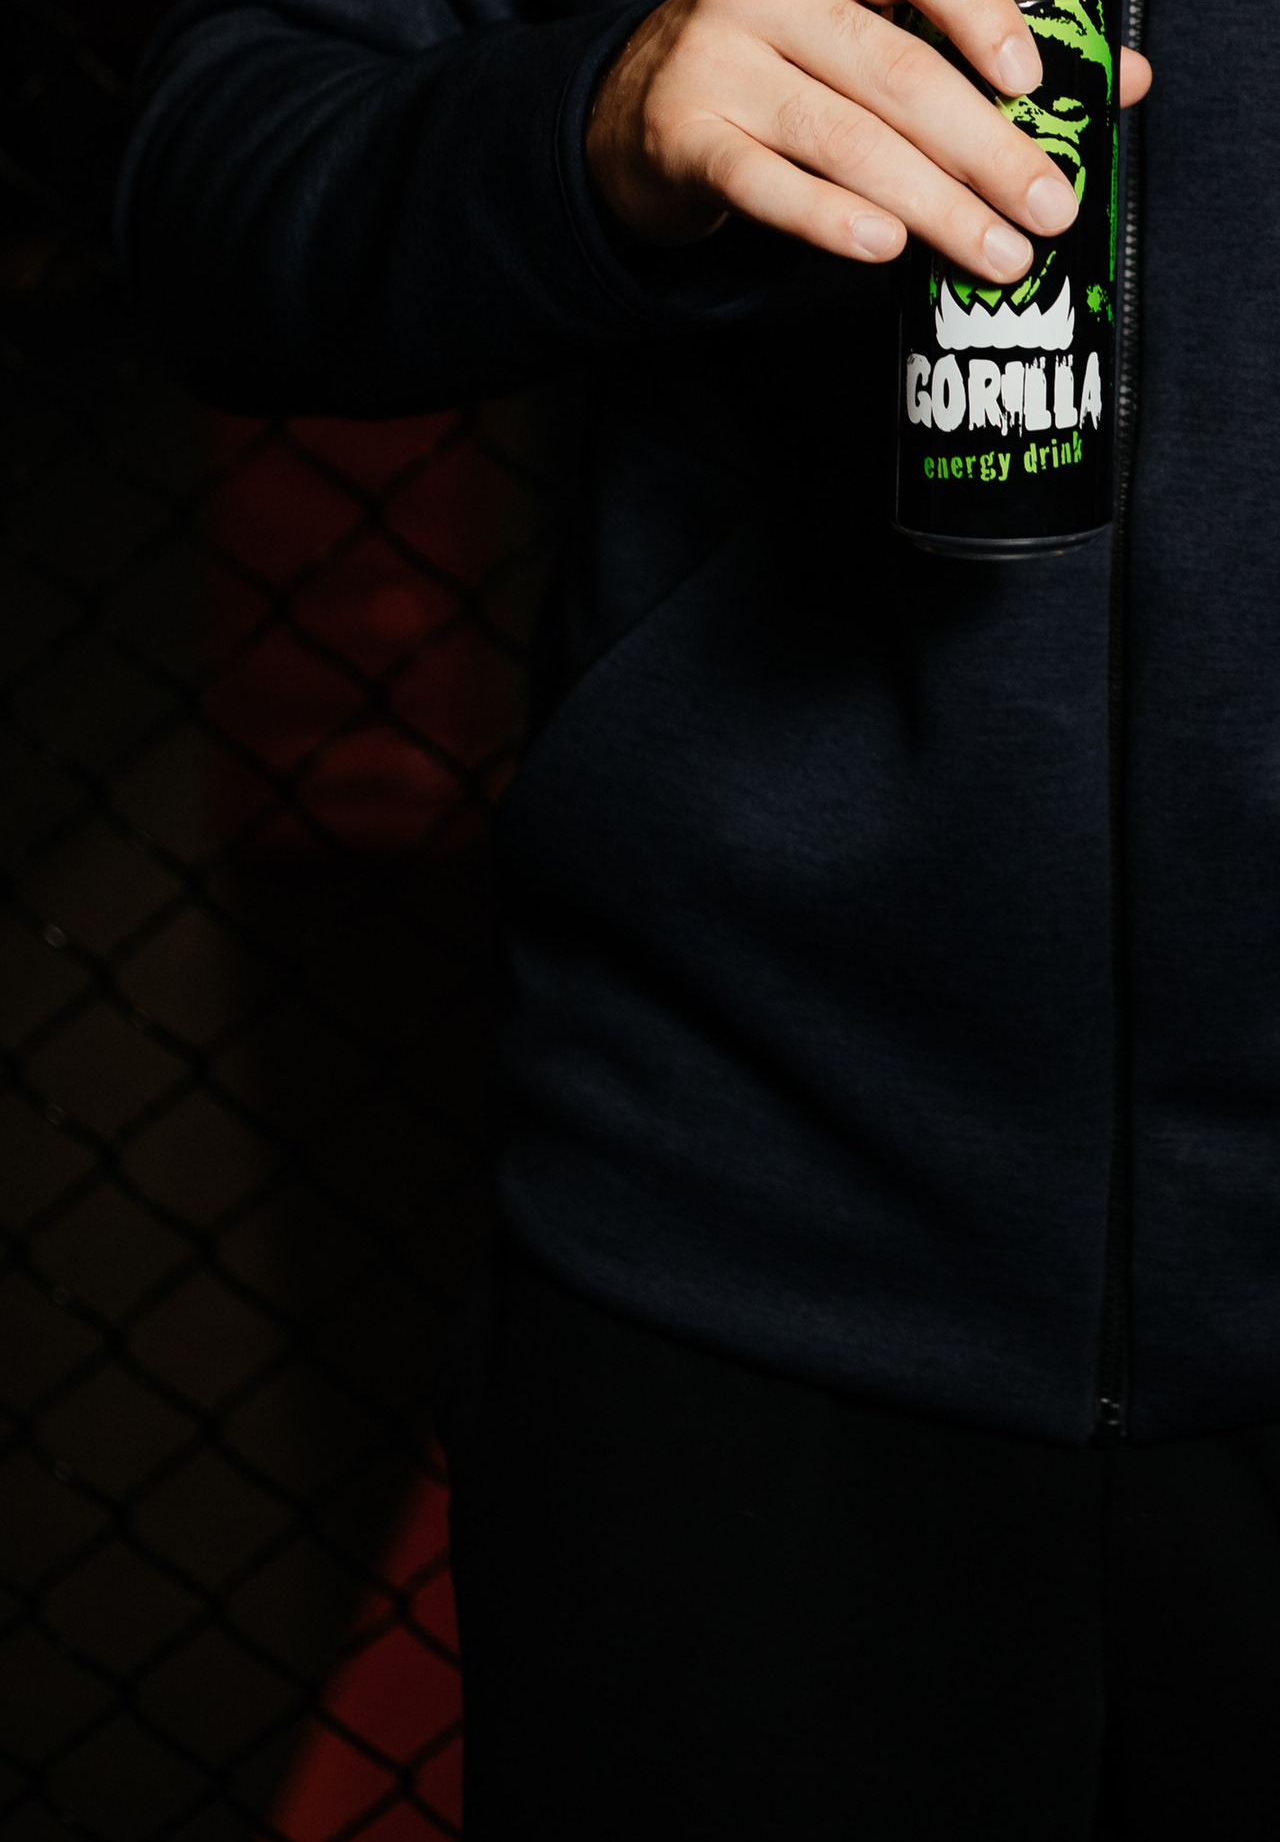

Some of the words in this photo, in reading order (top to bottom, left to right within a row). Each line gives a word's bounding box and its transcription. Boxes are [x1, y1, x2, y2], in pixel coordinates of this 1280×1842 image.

[906, 351, 1102, 438] GORILLA
[923, 450, 1011, 482] energy
[1023, 430, 1083, 474] drink
